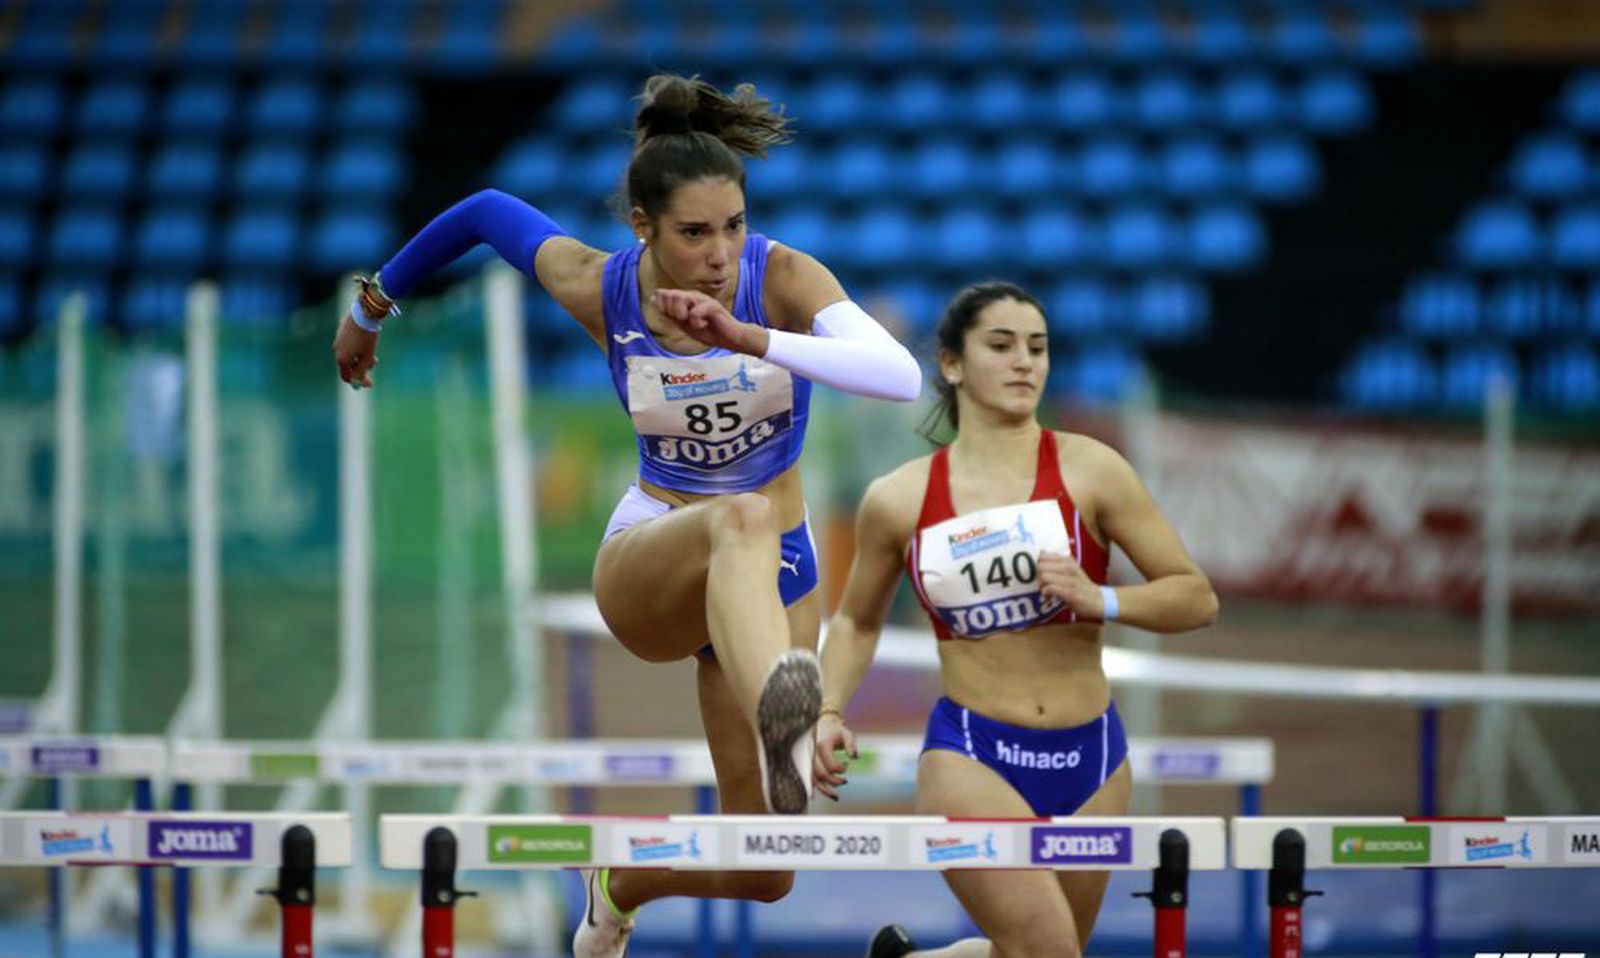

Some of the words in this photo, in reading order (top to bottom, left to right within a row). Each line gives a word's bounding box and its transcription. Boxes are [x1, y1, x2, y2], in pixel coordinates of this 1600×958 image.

[660, 372, 707, 386] Kinder
[684, 400, 742, 435] 85
[960, 551, 1038, 595] 140
[996, 740, 1081, 769] hinaco
[745, 835, 825, 855] MADRID
[835, 835, 882, 855] 2020
